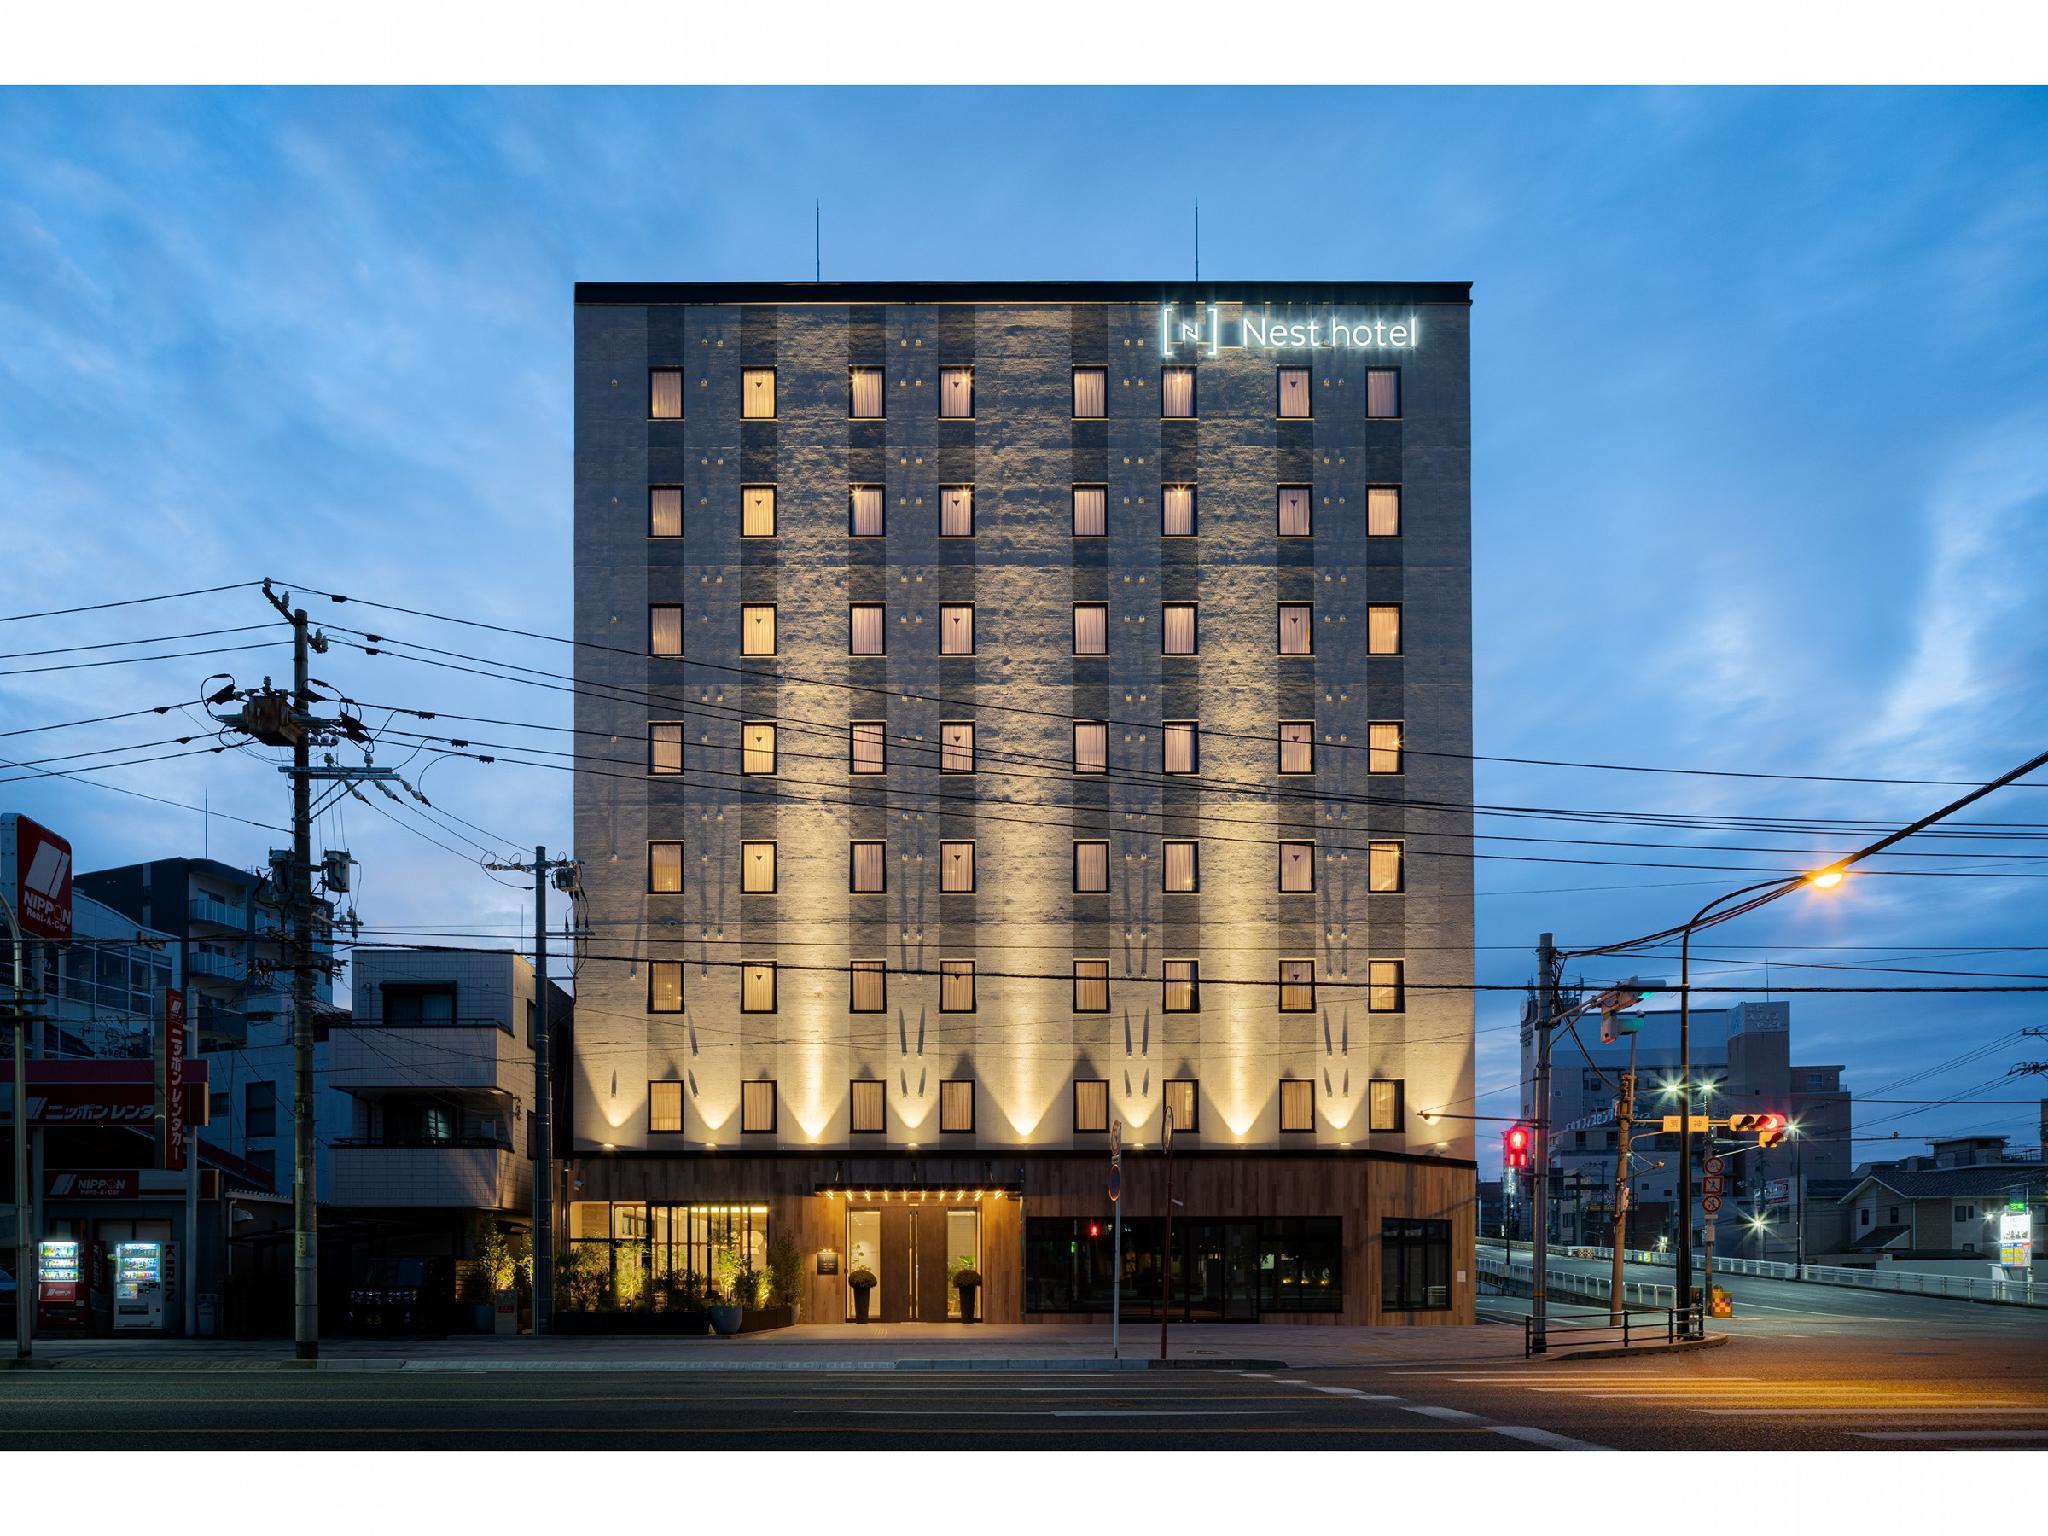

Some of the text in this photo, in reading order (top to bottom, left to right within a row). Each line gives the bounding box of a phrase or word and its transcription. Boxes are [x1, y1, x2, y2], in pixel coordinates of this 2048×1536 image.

[1242, 317, 1319, 347] Nest
[1332, 317, 1416, 347] hotel
[24, 890, 72, 926] NIPPON
[47, 1104, 155, 1120] ニッポンレンタ
[165, 1244, 176, 1302] KIRIN
